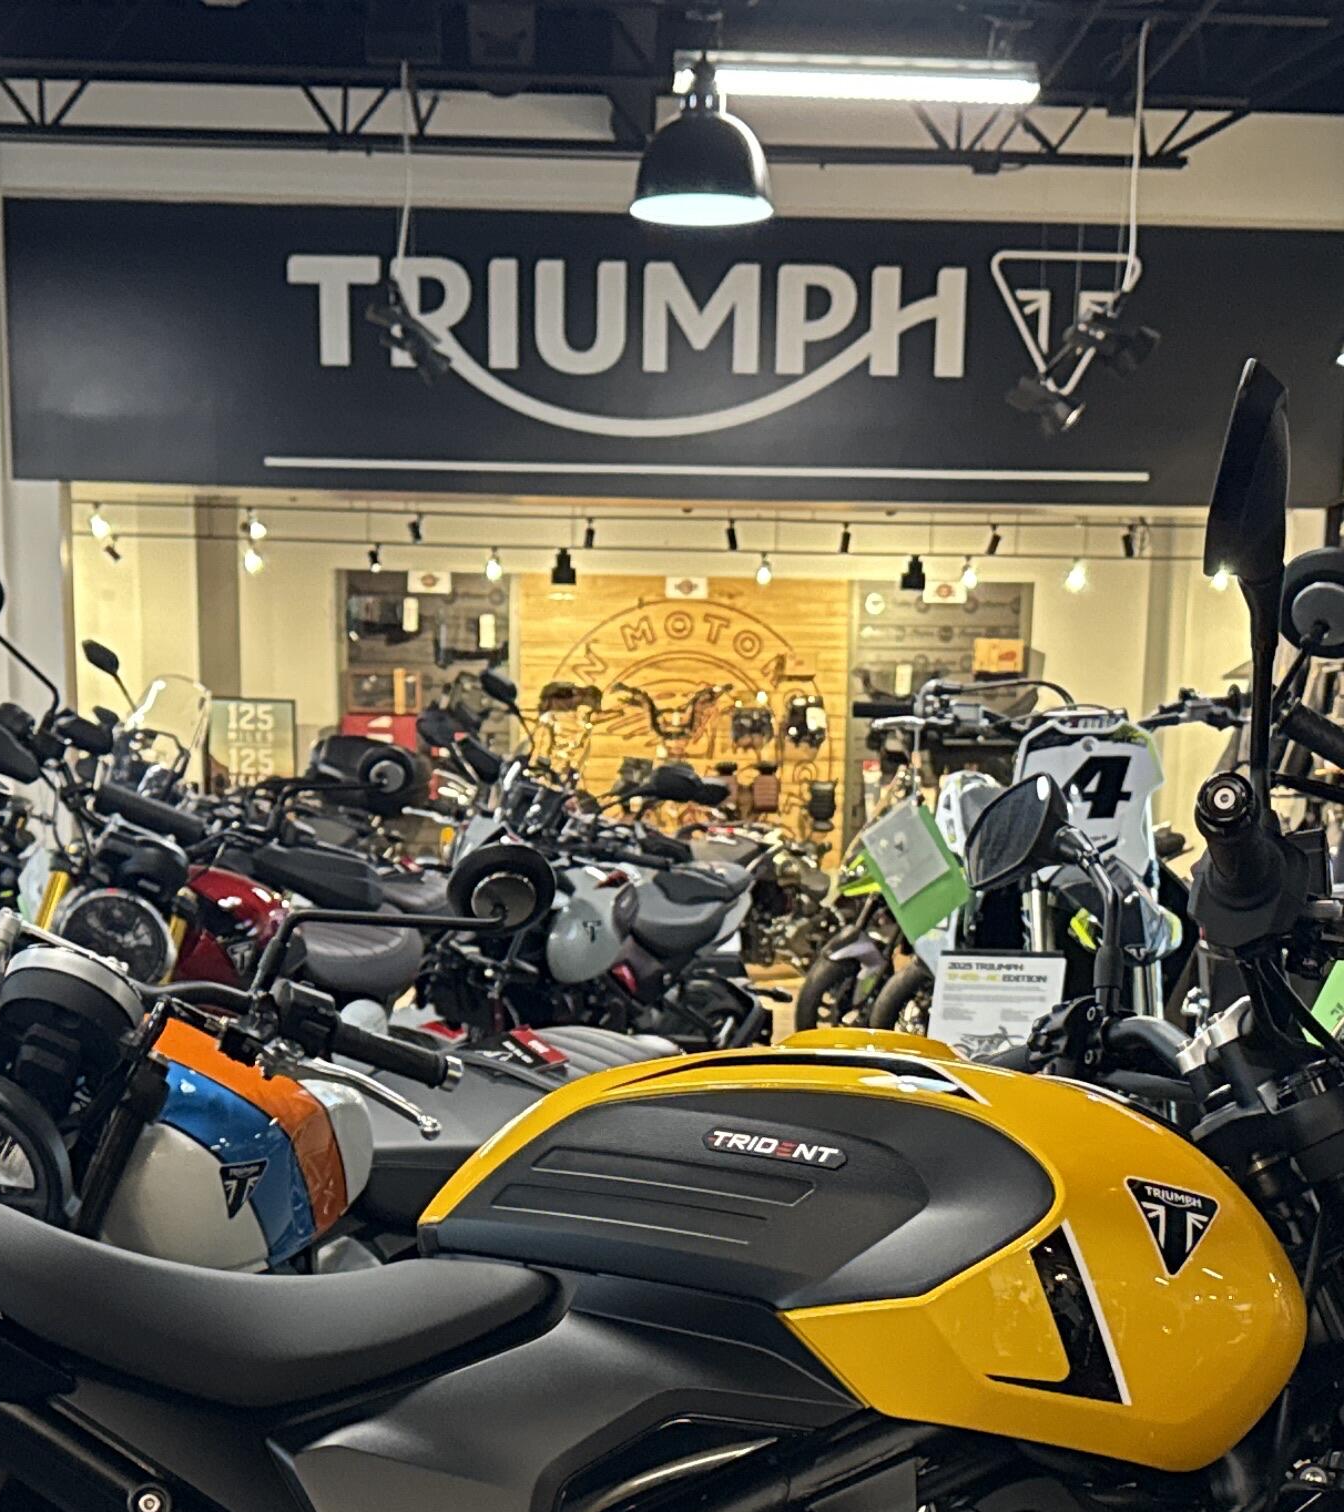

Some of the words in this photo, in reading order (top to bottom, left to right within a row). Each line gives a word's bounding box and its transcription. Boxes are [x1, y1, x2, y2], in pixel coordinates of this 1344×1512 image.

[287, 254, 968, 437] TRIUMPH
[228, 702, 274, 731] 125
[229, 747, 274, 776] 125
[1062, 755, 1132, 819] 4
[975, 962, 1025, 972] TRIUMPH
[713, 1130, 839, 1163] TRIDENT
[1143, 1185, 1203, 1209] TRIUMPH
